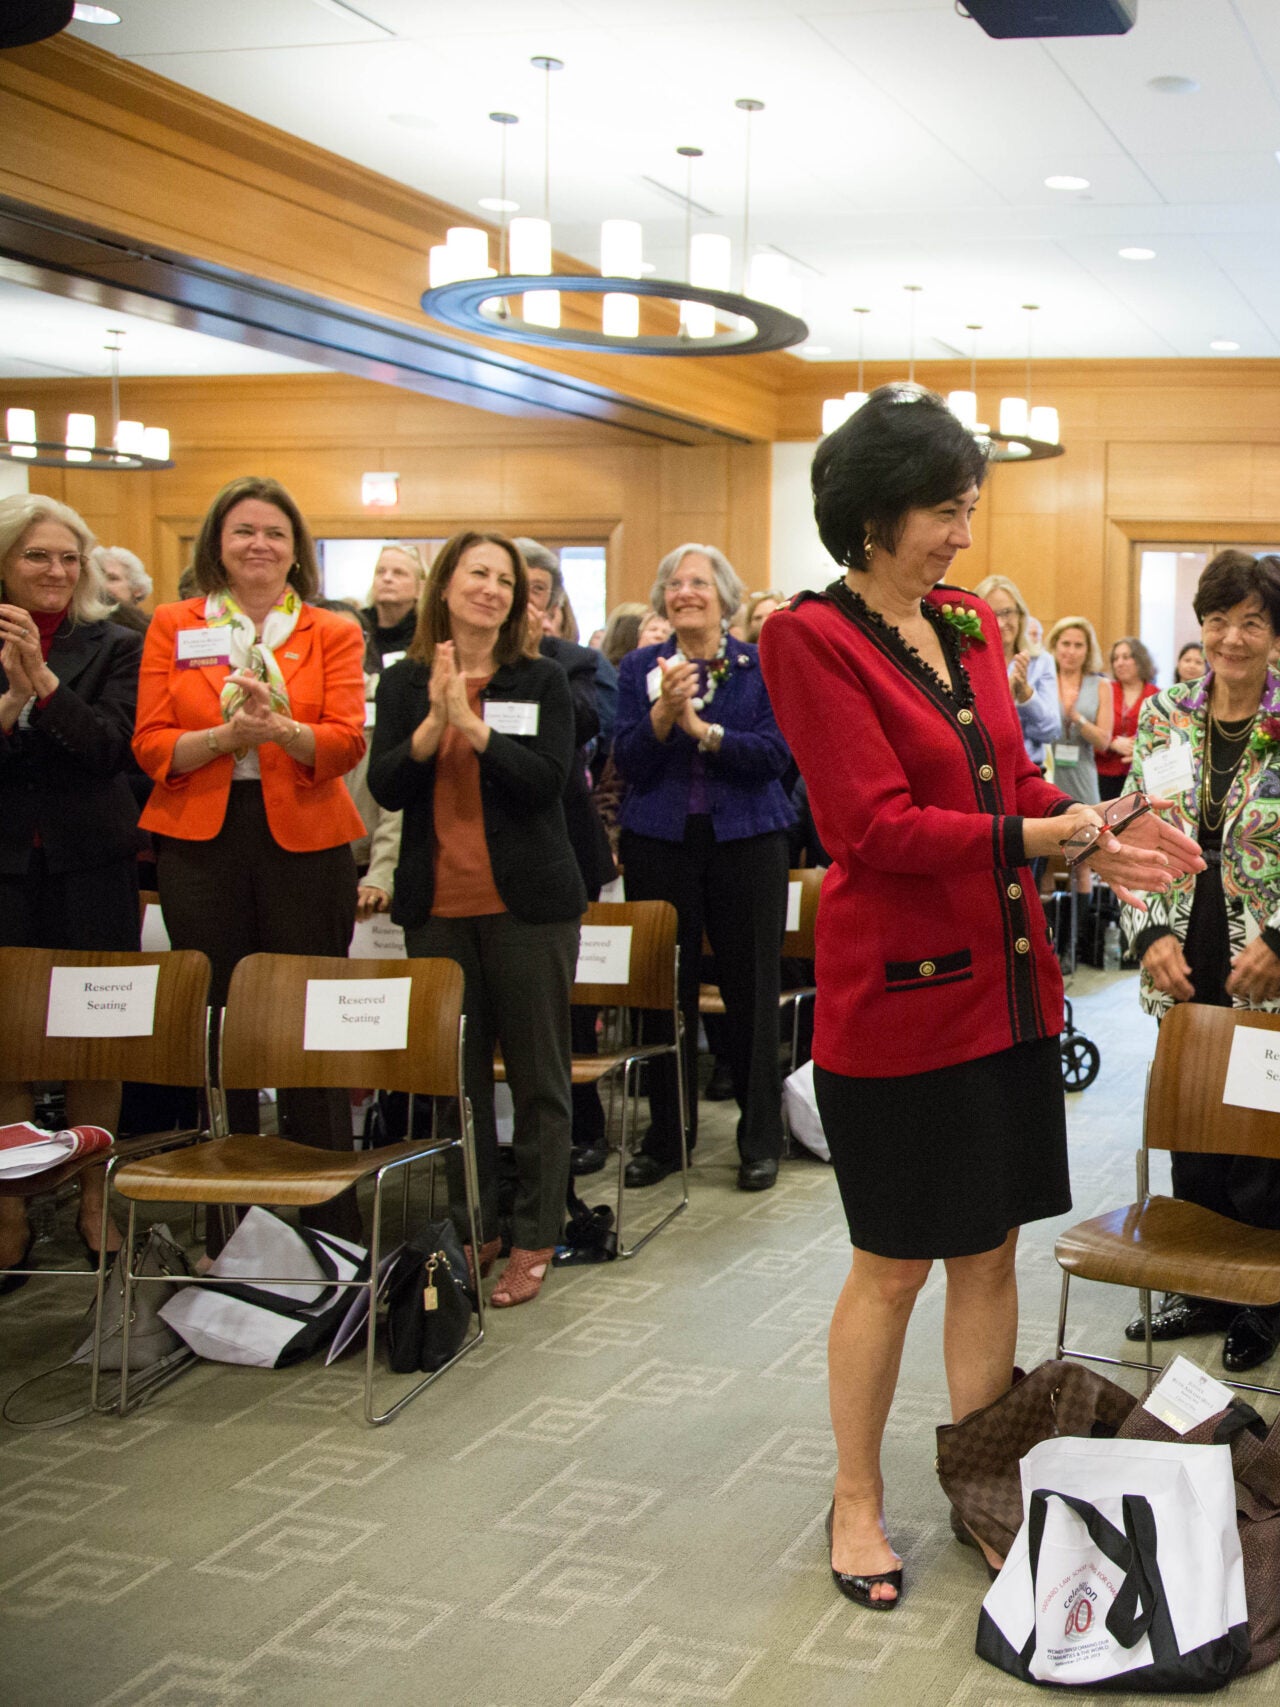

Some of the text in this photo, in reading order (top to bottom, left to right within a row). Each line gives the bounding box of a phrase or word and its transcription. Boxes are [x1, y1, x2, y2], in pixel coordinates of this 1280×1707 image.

[579, 953, 607, 964] eating
[84, 981, 133, 992] Reserved
[338, 994, 386, 1005] Reserved
[87, 1000, 127, 1012] Seating
[341, 1012, 381, 1025] Seating
[1060, 1575, 1071, 1589] LAW
[1097, 1570, 1108, 1583] FOR
